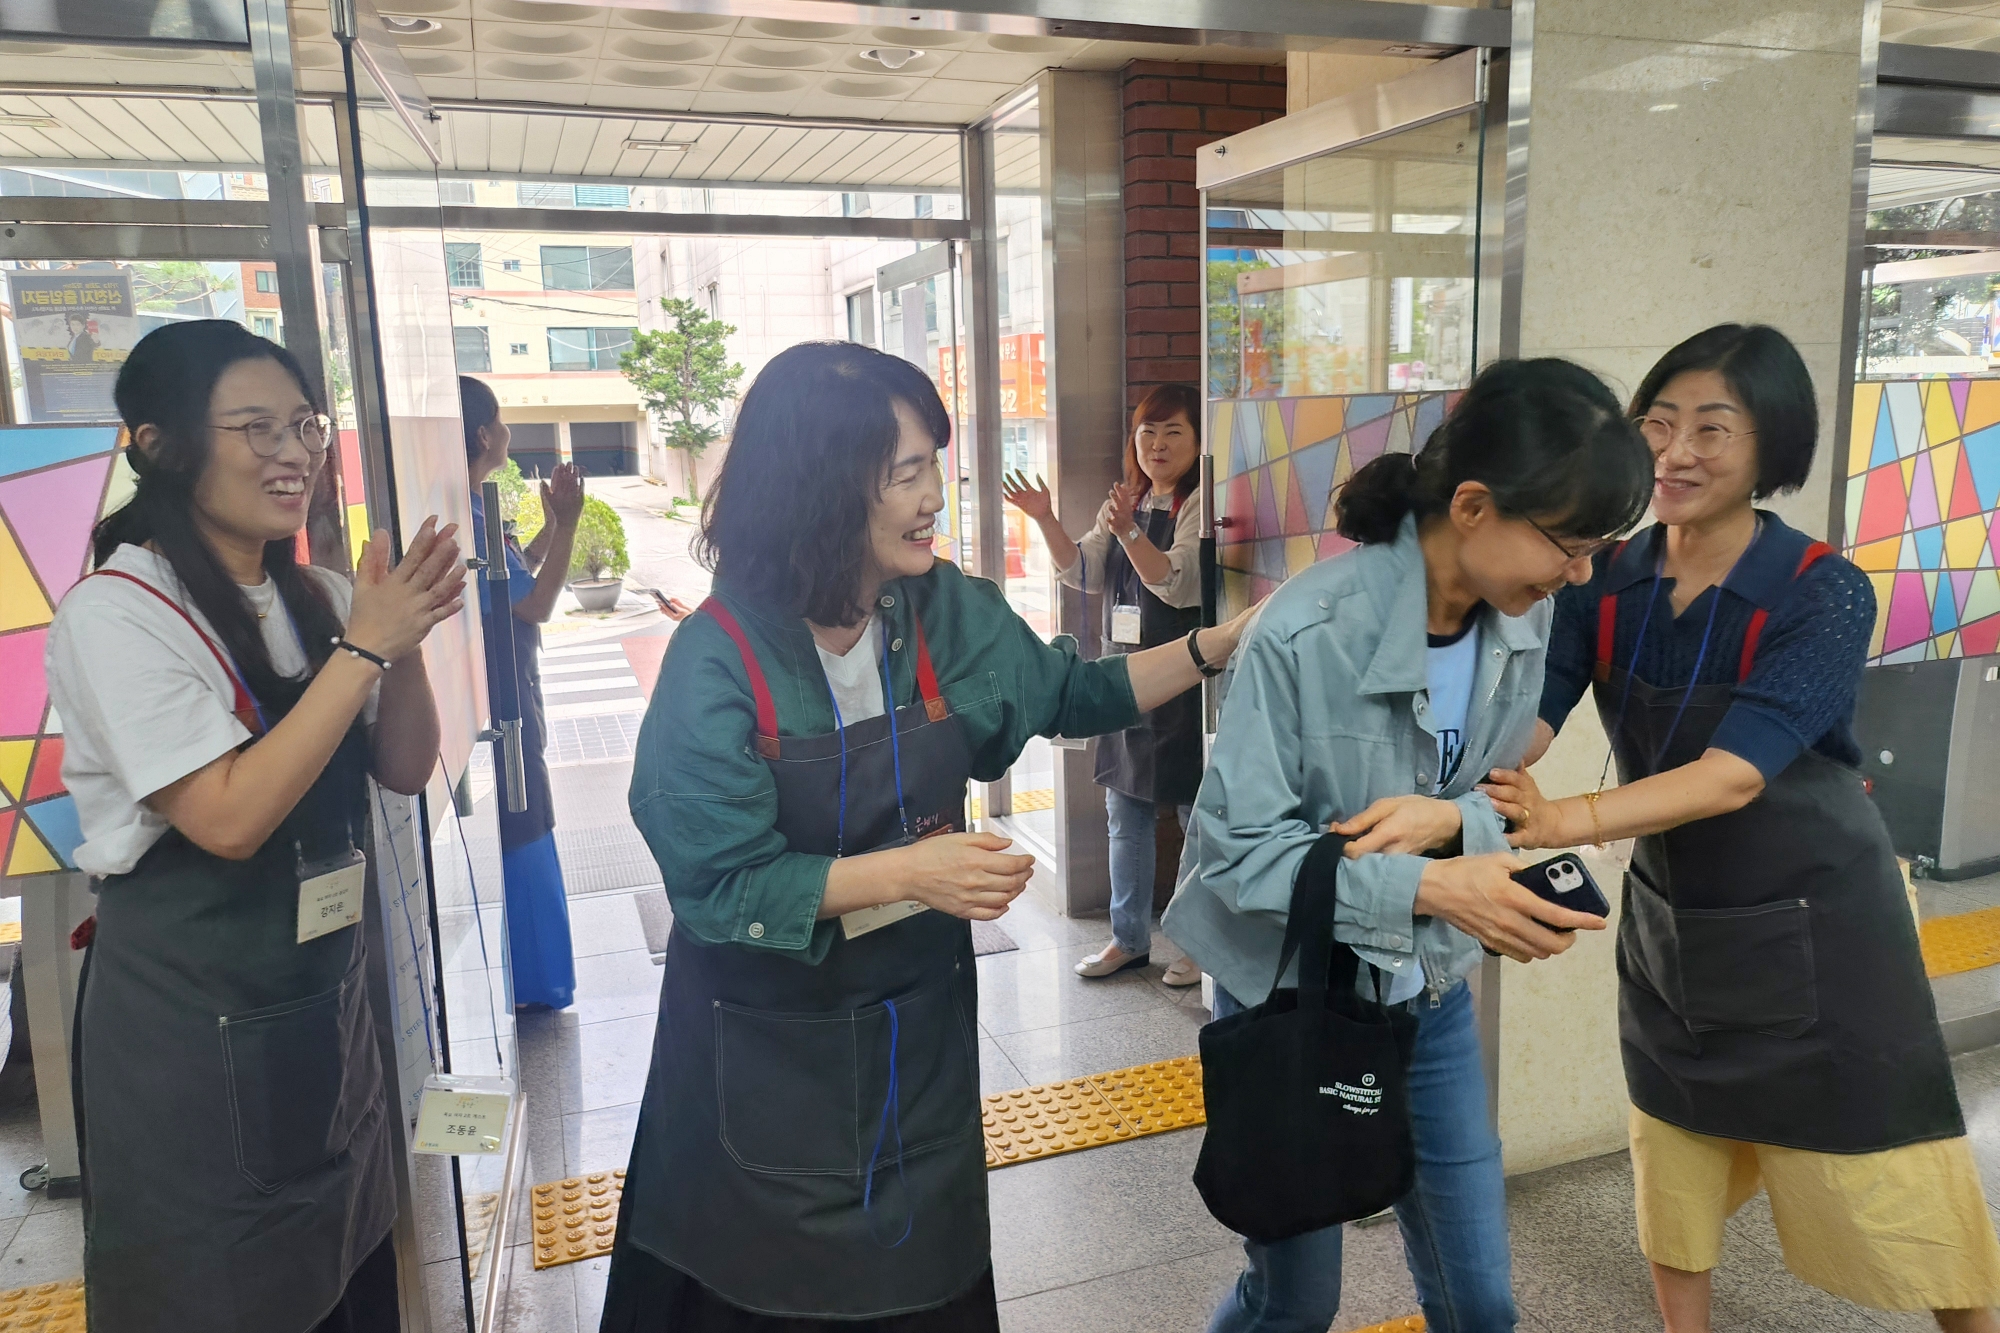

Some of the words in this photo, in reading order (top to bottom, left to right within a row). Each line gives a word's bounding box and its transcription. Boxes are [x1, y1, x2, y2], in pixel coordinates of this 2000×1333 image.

[1319, 1087, 1338, 1095] BASIC
[1339, 1090, 1373, 1103] NATURAL
[446, 1125, 476, 1135] 조동윤
